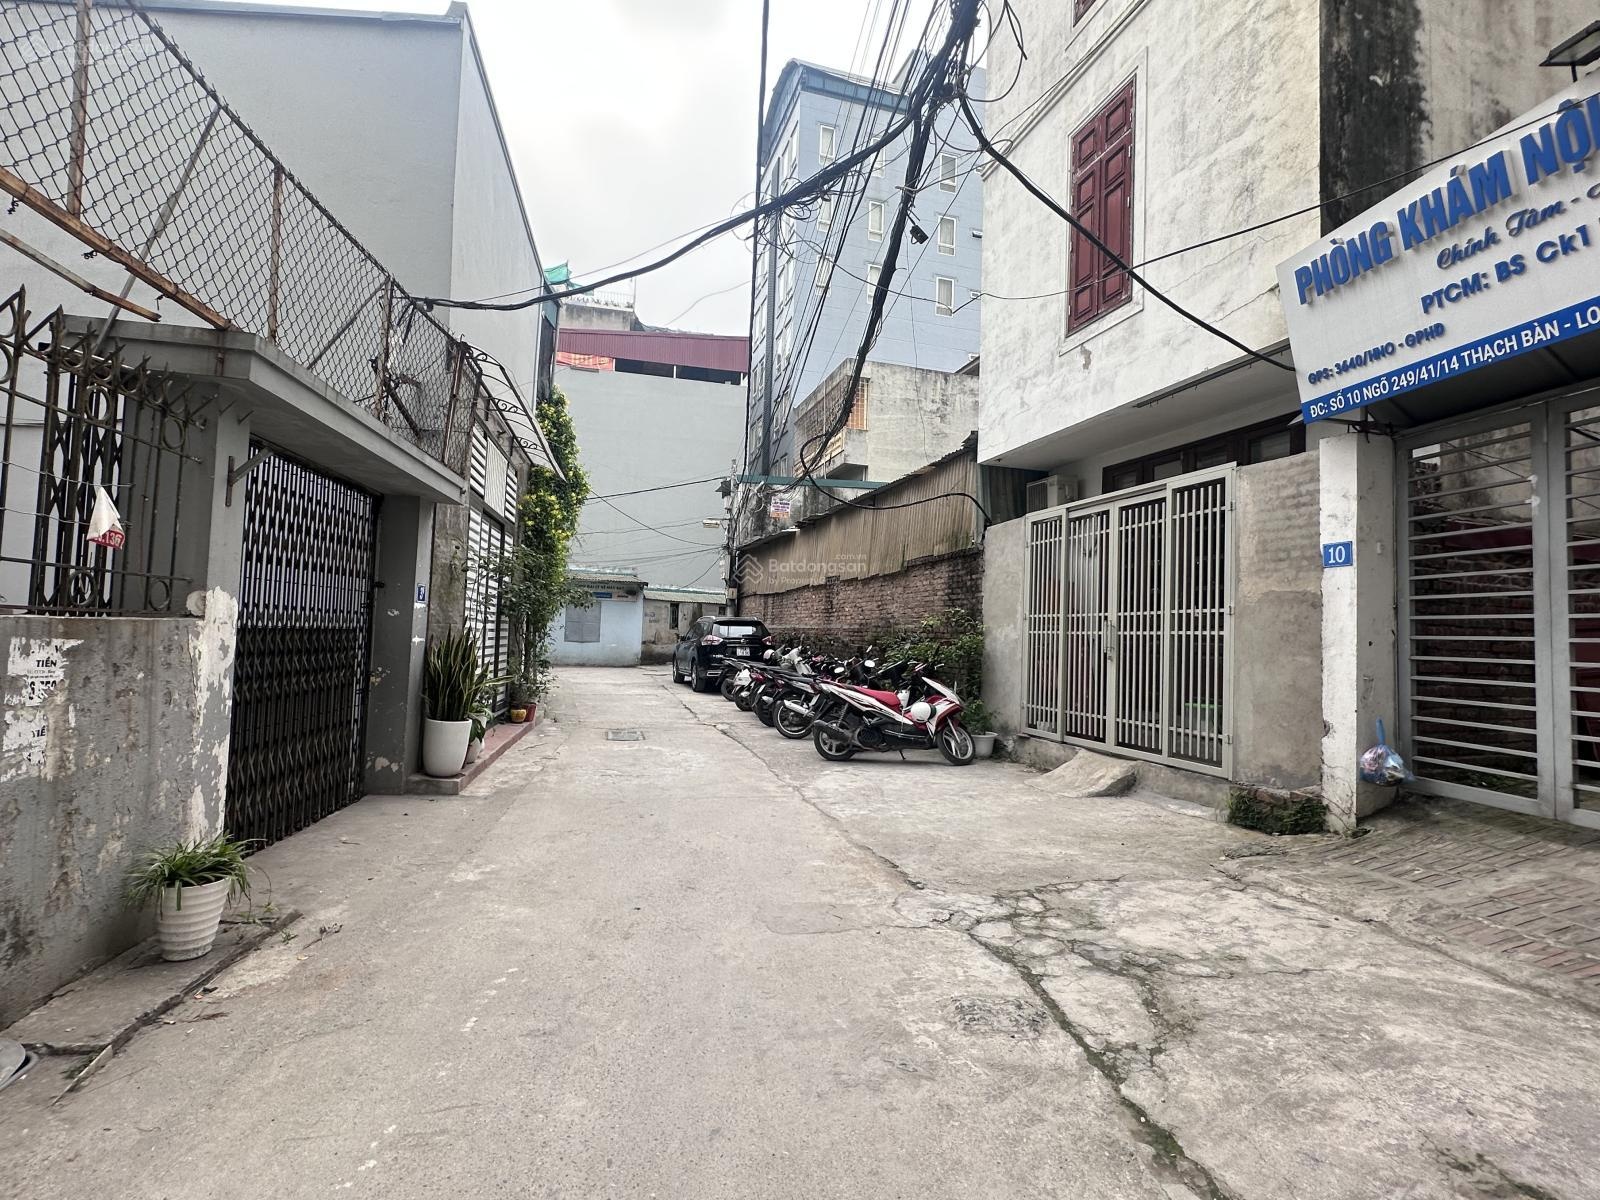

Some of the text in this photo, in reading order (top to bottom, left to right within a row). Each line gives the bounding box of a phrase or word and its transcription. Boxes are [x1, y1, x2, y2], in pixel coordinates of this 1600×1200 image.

[1294, 92, 1600, 305] PHÒNG KHÁM NỘI
[1436, 226, 1501, 270] Chính
[1505, 200, 1567, 237] Tâm
[1420, 272, 1491, 314] PTCM:
[1494, 254, 1527, 283] BS
[1309, 402, 1329, 418] ĐC:
[1330, 388, 1345, 411] SỐ
[1346, 389, 1361, 406] 10
[1362, 377, 1390, 401] NGÕ
[1391, 355, 1460, 391] 249/41/14
[1460, 334, 1518, 367] THẠCH
[1520, 320, 1560, 348] BÀN
[1328, 545, 1346, 564] 10
